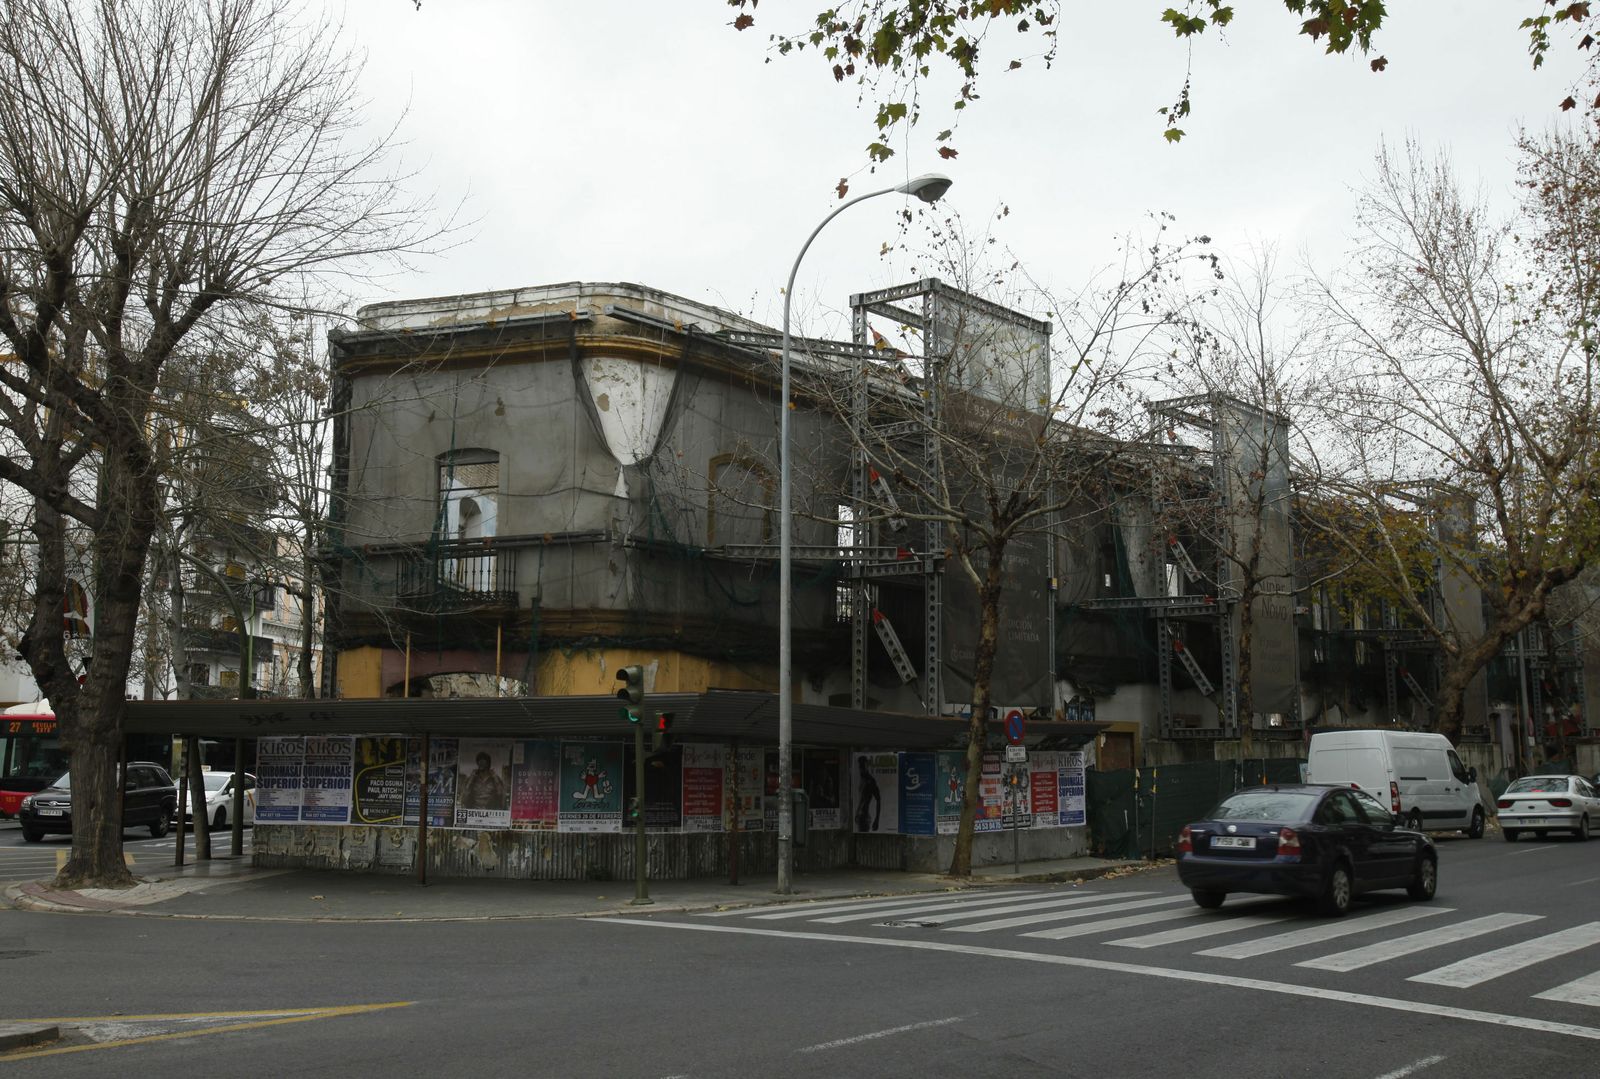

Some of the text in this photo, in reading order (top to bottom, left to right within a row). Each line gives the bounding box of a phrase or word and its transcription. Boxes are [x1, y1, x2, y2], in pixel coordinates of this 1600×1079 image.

[1008, 631, 1041, 642] LIMITADA
[9, 721, 21, 733] 27
[259, 742, 304, 755] KIROS
[305, 742, 351, 756] KIROS
[1058, 756, 1083, 768] KIROS
[302, 778, 351, 790] SUPERIOR
[1059, 787, 1084, 797] SUPERIOR
[468, 810, 489, 818] SEVILLA
